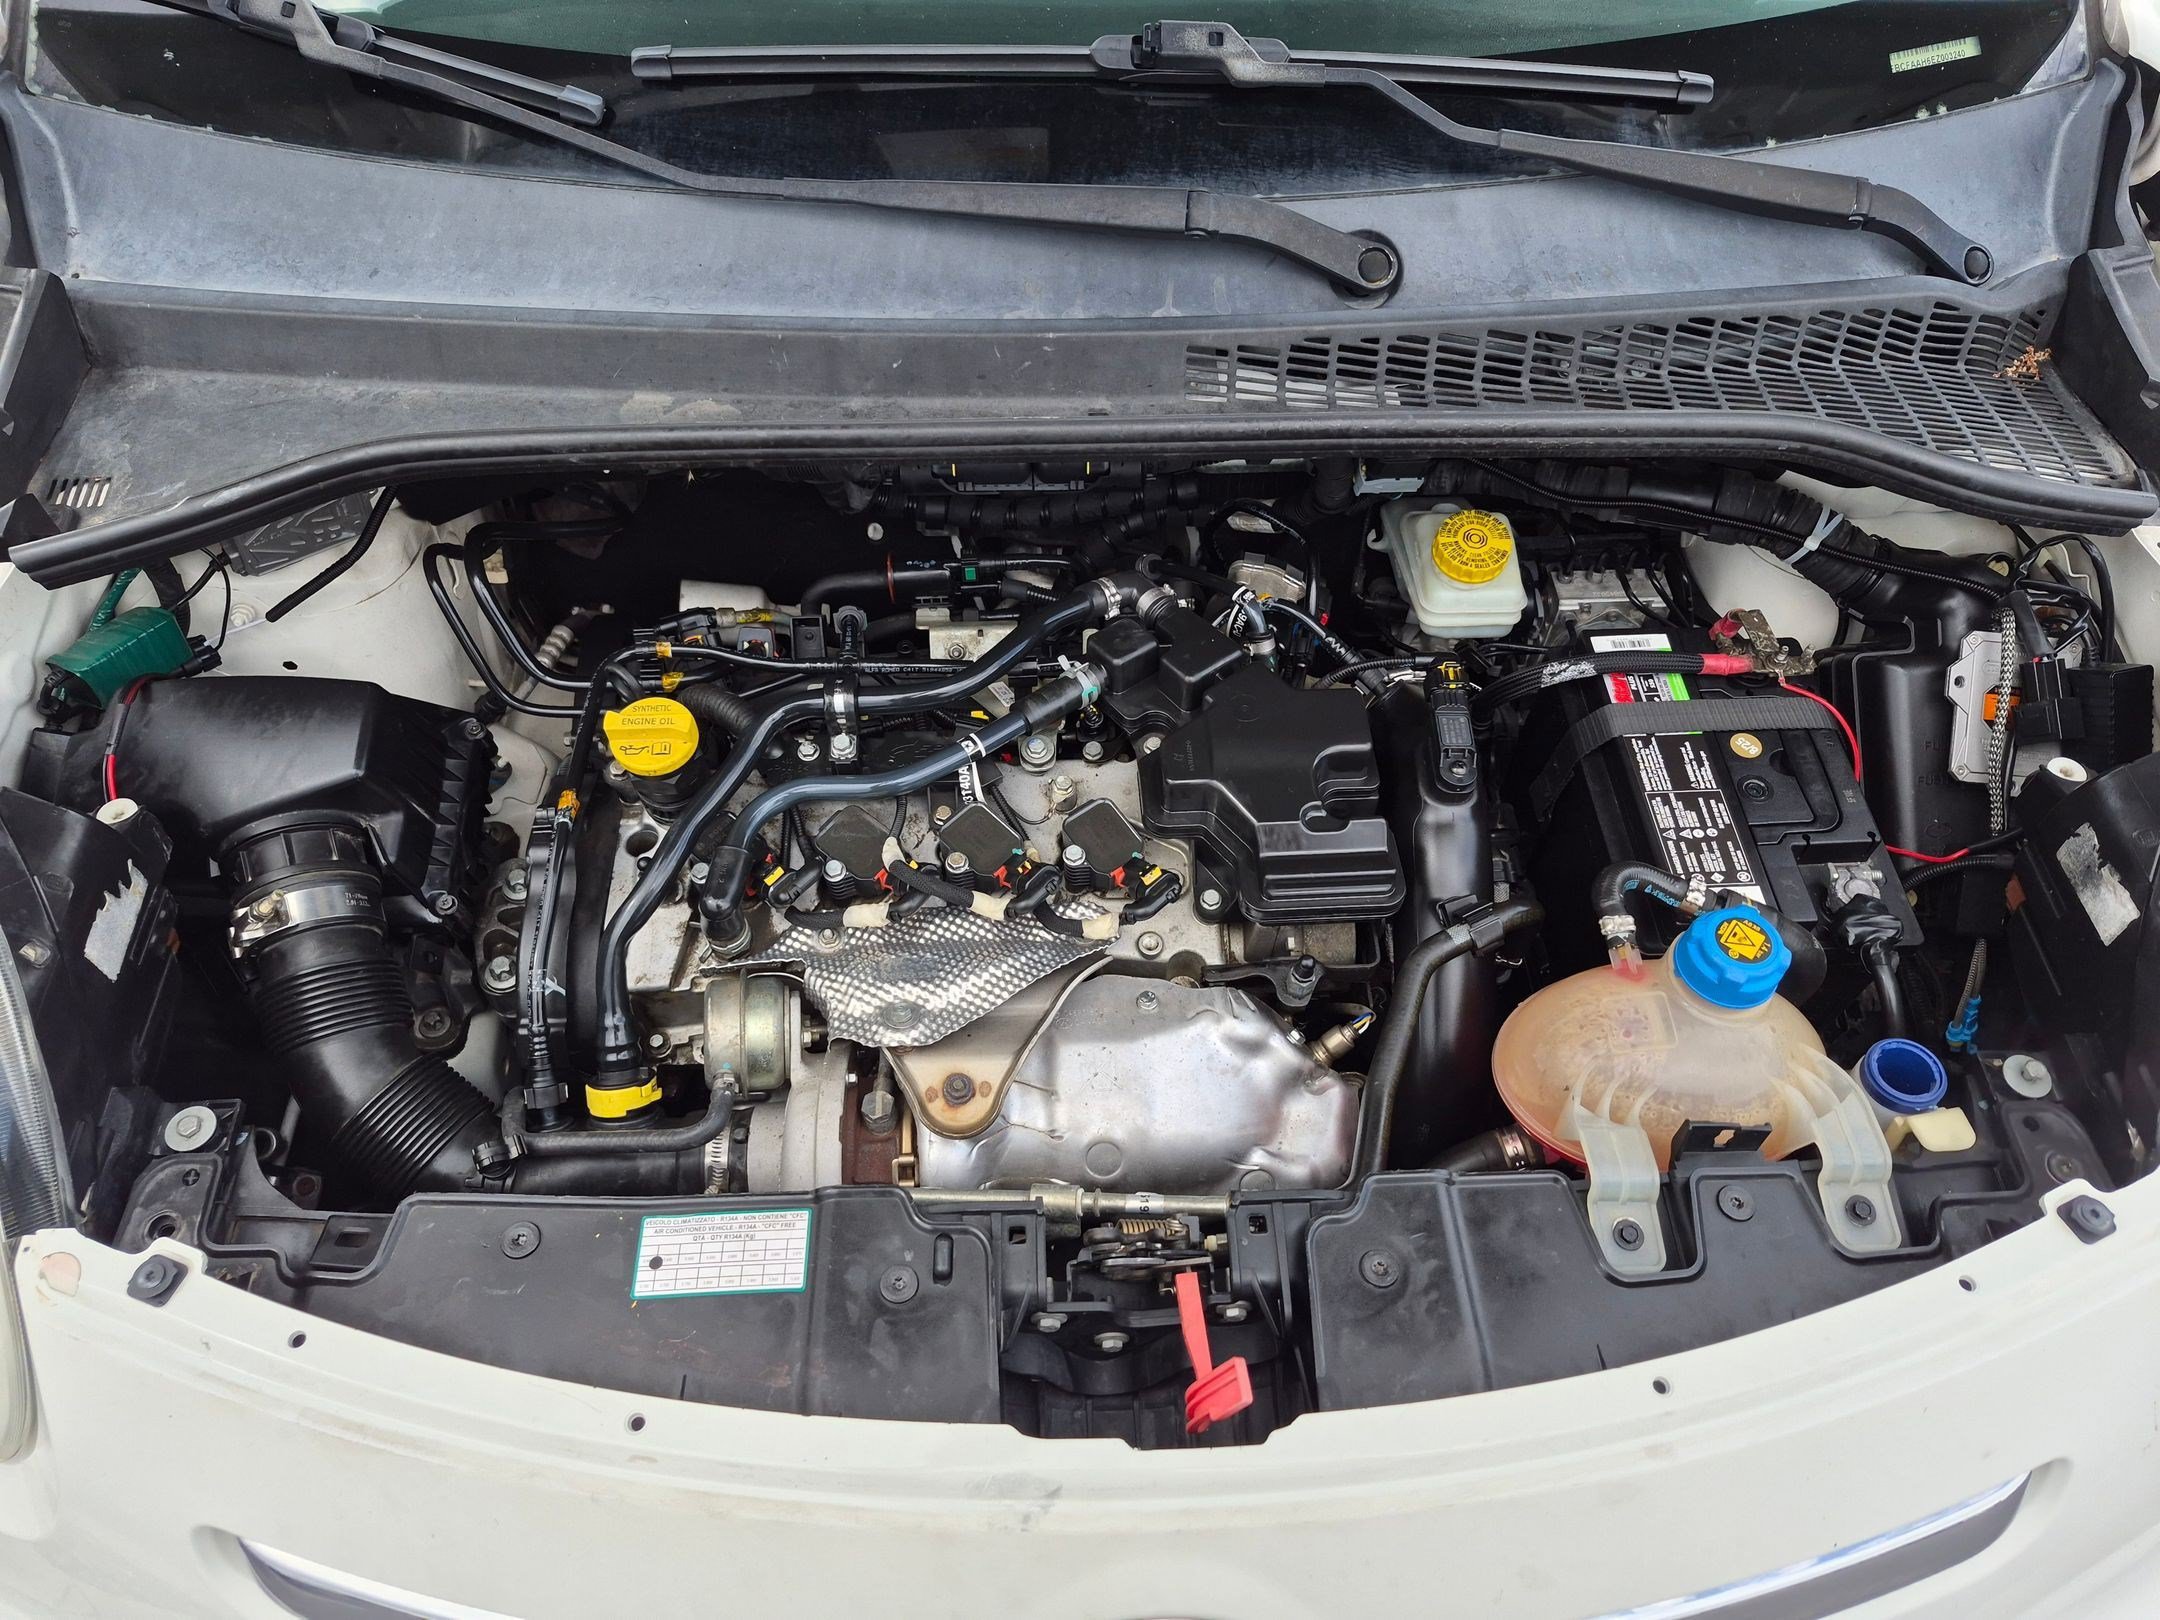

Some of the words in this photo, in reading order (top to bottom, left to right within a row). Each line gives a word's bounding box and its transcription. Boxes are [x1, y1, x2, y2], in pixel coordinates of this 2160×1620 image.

[632, 705, 671, 713] SYNTHETIC
[621, 718, 657, 726] ENGINE
[673, 1217, 715, 1225] CLIMATIZZATO
[665, 1226, 707, 1234] CONDITIONED
